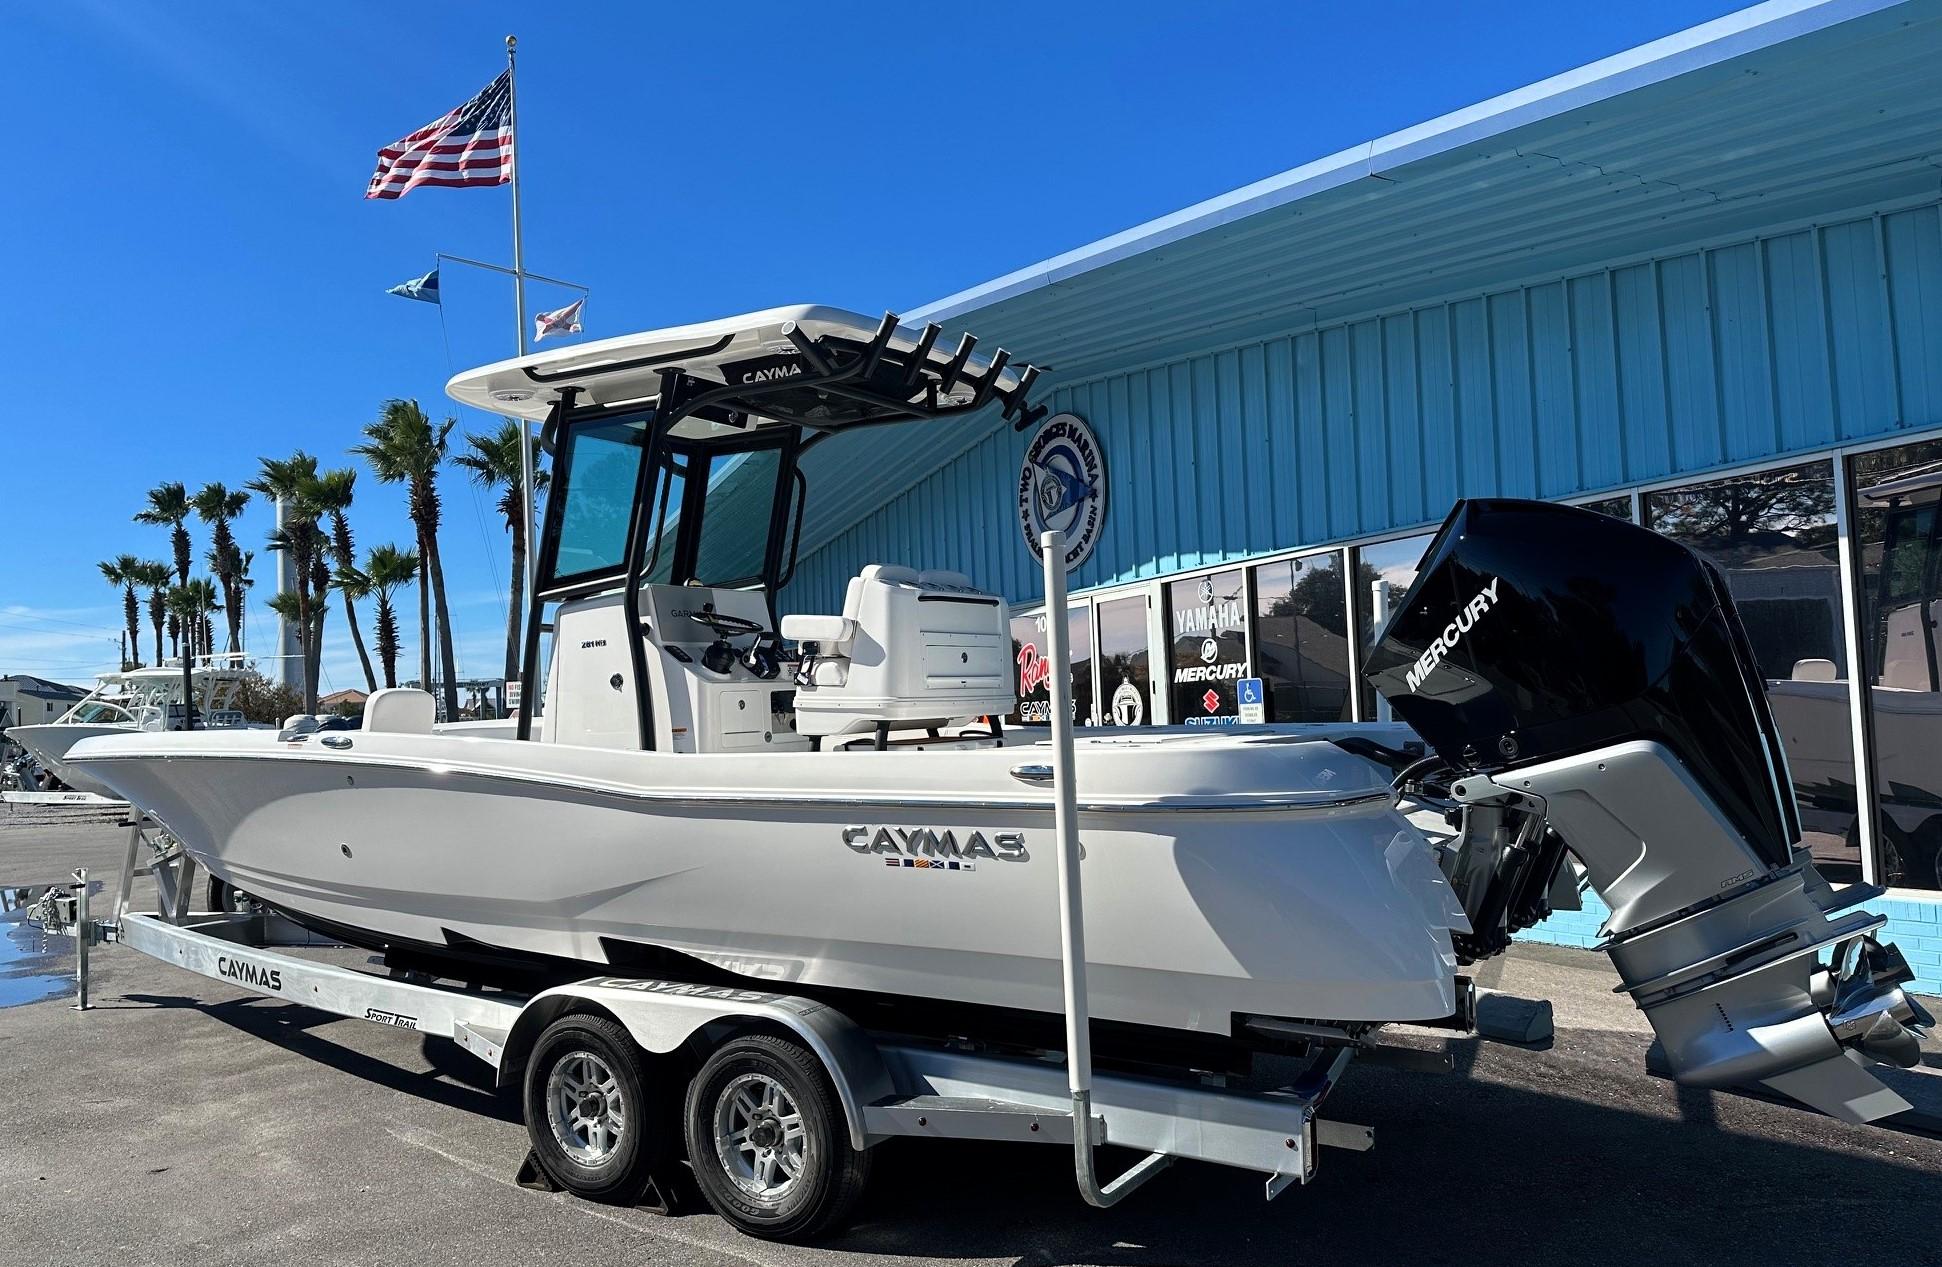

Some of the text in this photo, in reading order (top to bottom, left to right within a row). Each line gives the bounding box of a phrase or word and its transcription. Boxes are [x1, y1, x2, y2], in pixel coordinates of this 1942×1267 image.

[742, 363, 801, 384] CAYMA
[1019, 466, 1033, 507] TWO
[1067, 423, 1099, 487] MARINA
[1176, 602, 1240, 633] YAMAHA
[1405, 576, 1498, 693] MERCURY
[1174, 662, 1248, 683] MERCURY
[842, 825, 1029, 861] CAYMAS
[218, 956, 282, 991] CAYMAS
[599, 978, 769, 1001] CAYMAS
[365, 1007, 418, 1030] SPORT TRAIL
